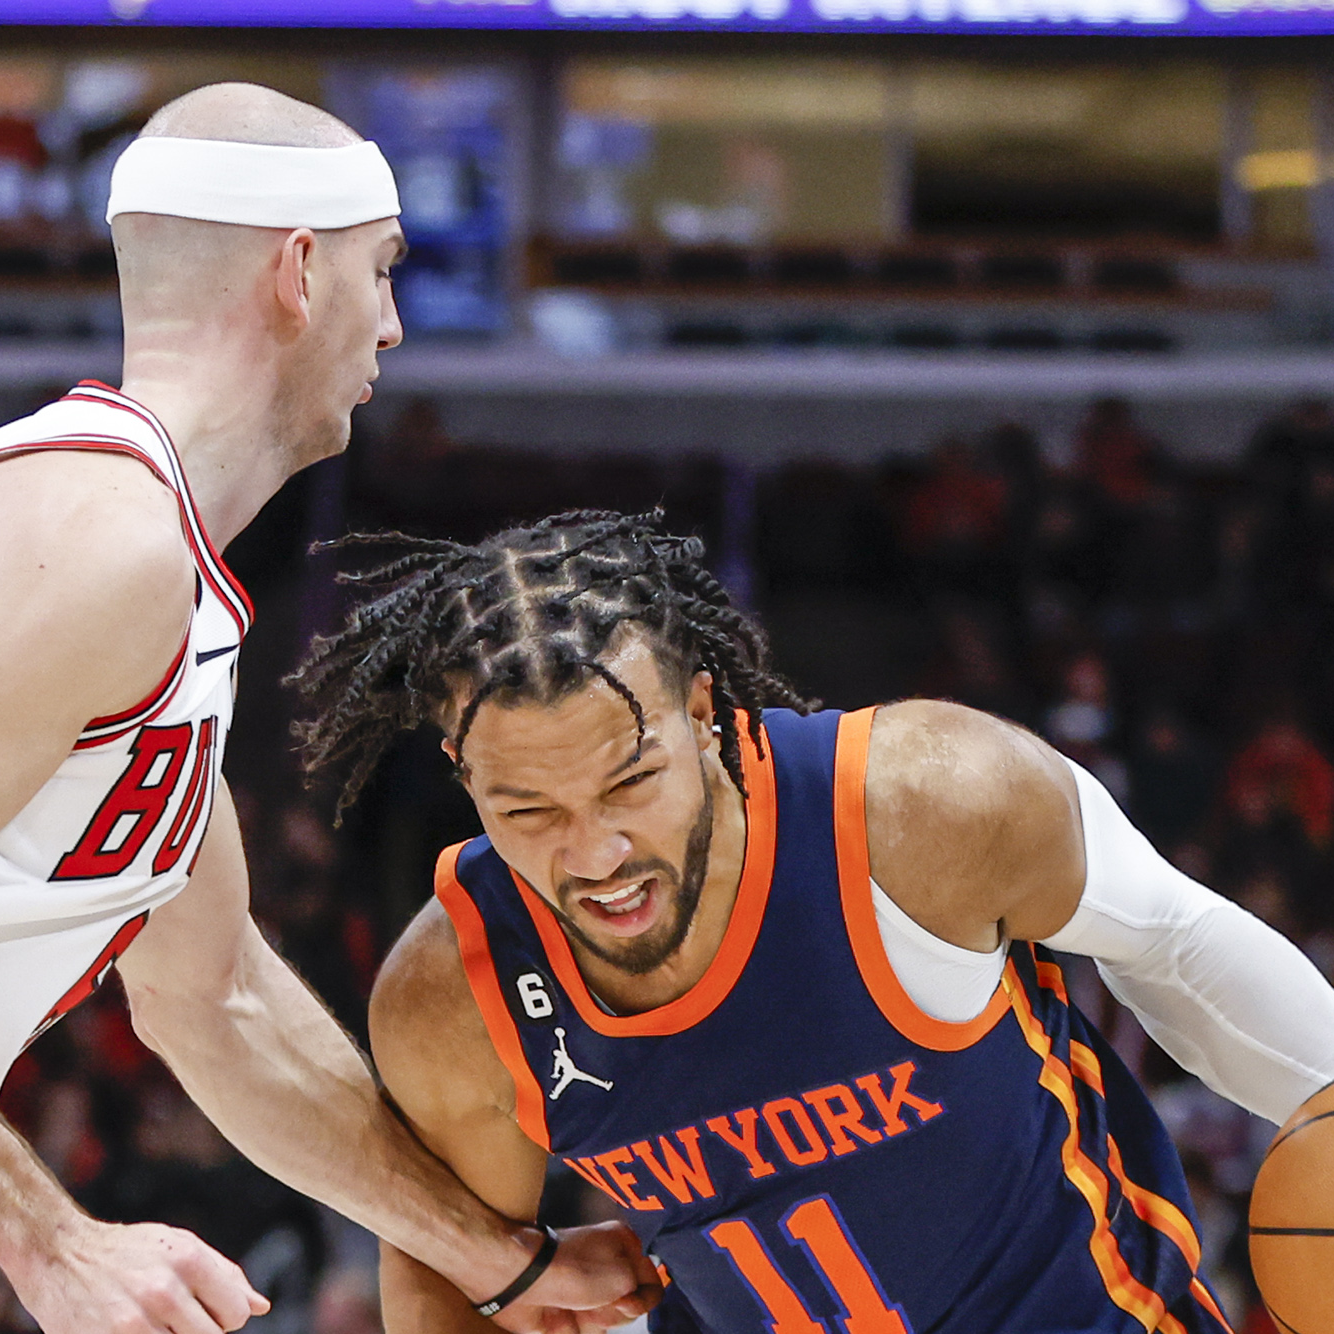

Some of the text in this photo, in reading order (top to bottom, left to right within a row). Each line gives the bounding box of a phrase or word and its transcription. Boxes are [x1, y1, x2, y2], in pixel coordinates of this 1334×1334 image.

[46, 714, 220, 882] BU
[516, 972, 554, 1019] 6
[563, 1060, 945, 1212] NEW YORK
